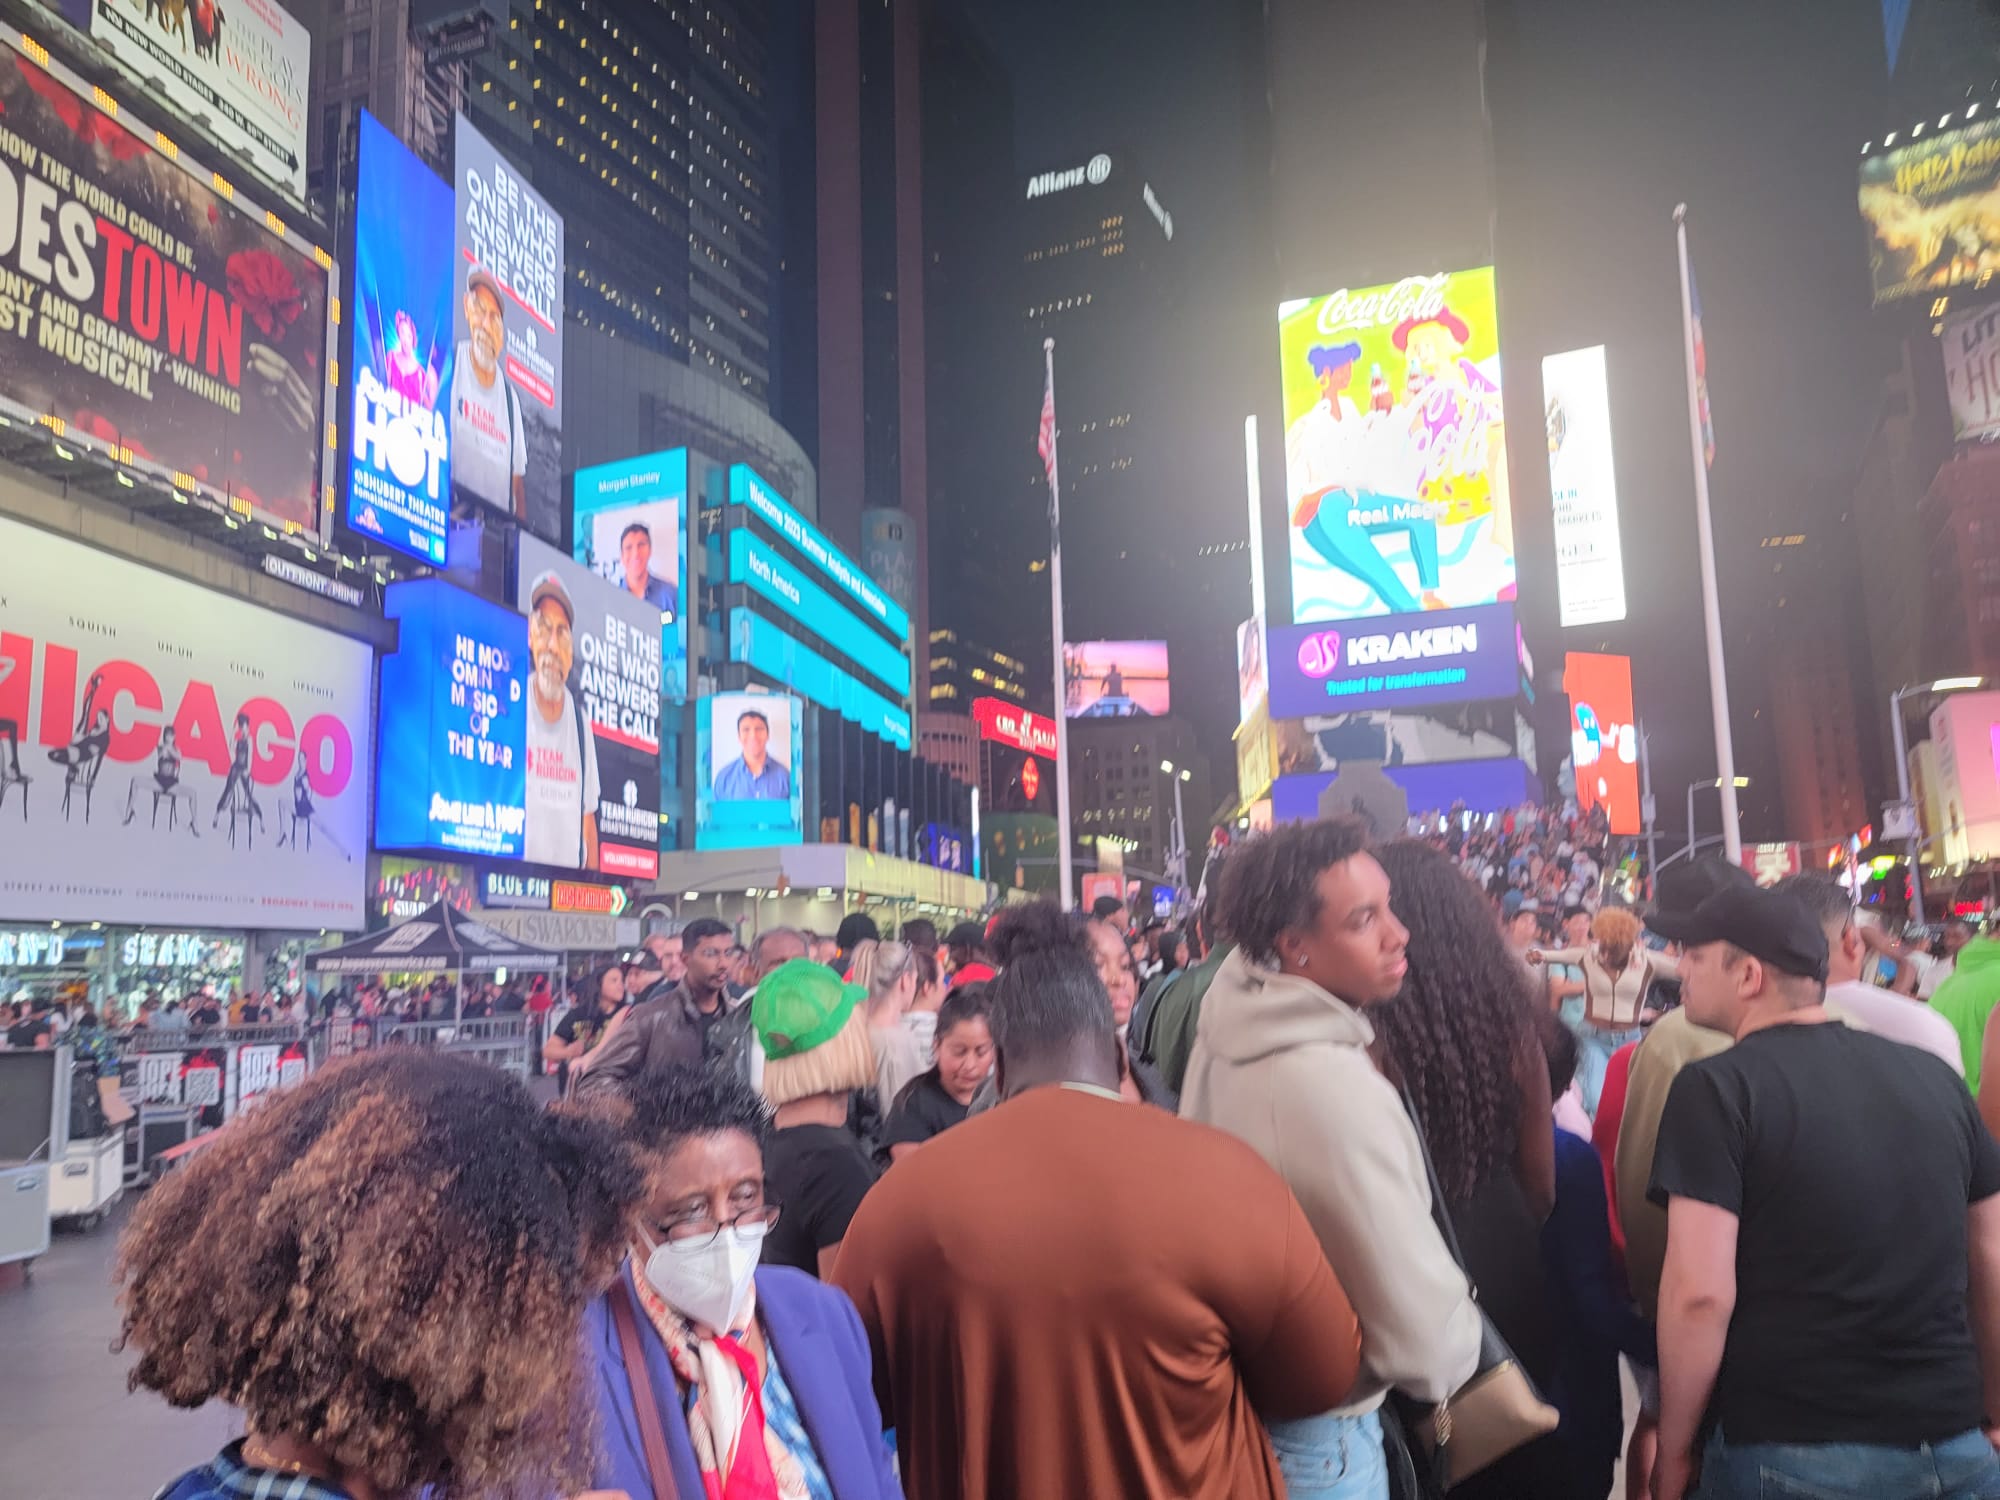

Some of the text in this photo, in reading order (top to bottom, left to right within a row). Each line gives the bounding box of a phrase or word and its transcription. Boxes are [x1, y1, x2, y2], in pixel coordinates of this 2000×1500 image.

[226, 47, 301, 129] WRONG
[40, 152, 72, 192] THE
[74, 173, 127, 227] WORLD
[129, 211, 174, 257] COULD
[495, 162, 556, 250] BE THE
[1027, 166, 1085, 200] Allianz
[466, 167, 556, 274] ONE WHO
[466, 198, 556, 301] ANSWERS
[470, 227, 556, 329] THE CALL
[40, 290, 79, 331] AND
[38, 314, 153, 401] MUSICAL
[354, 384, 447, 500] HOT
[598, 471, 661, 494] Morgan Stanley
[749, 479, 783, 528] Welcome
[783, 510, 801, 543] 2023
[801, 526, 828, 565] Summer
[1347, 504, 1391, 528] Real
[748, 549, 800, 606] North America
[68, 615, 117, 639] SQUISH
[605, 612, 660, 665] BE THE
[1347, 623, 1478, 667] KRAKEN
[229, 661, 265, 680] CICERO
[580, 631, 660, 692] ONE WHO
[1326, 667, 1467, 696] Trusted for transformation
[580, 661, 660, 720] ANSWERS
[584, 692, 659, 746] THE CALL
[447, 729, 513, 770] THE YEAR
[535, 747, 563, 764] TEAM
[601, 800, 659, 829] TEAM RUBICON
[488, 872, 551, 899] BLUE FIN
[526, 914, 617, 945] SWAROVSKI
